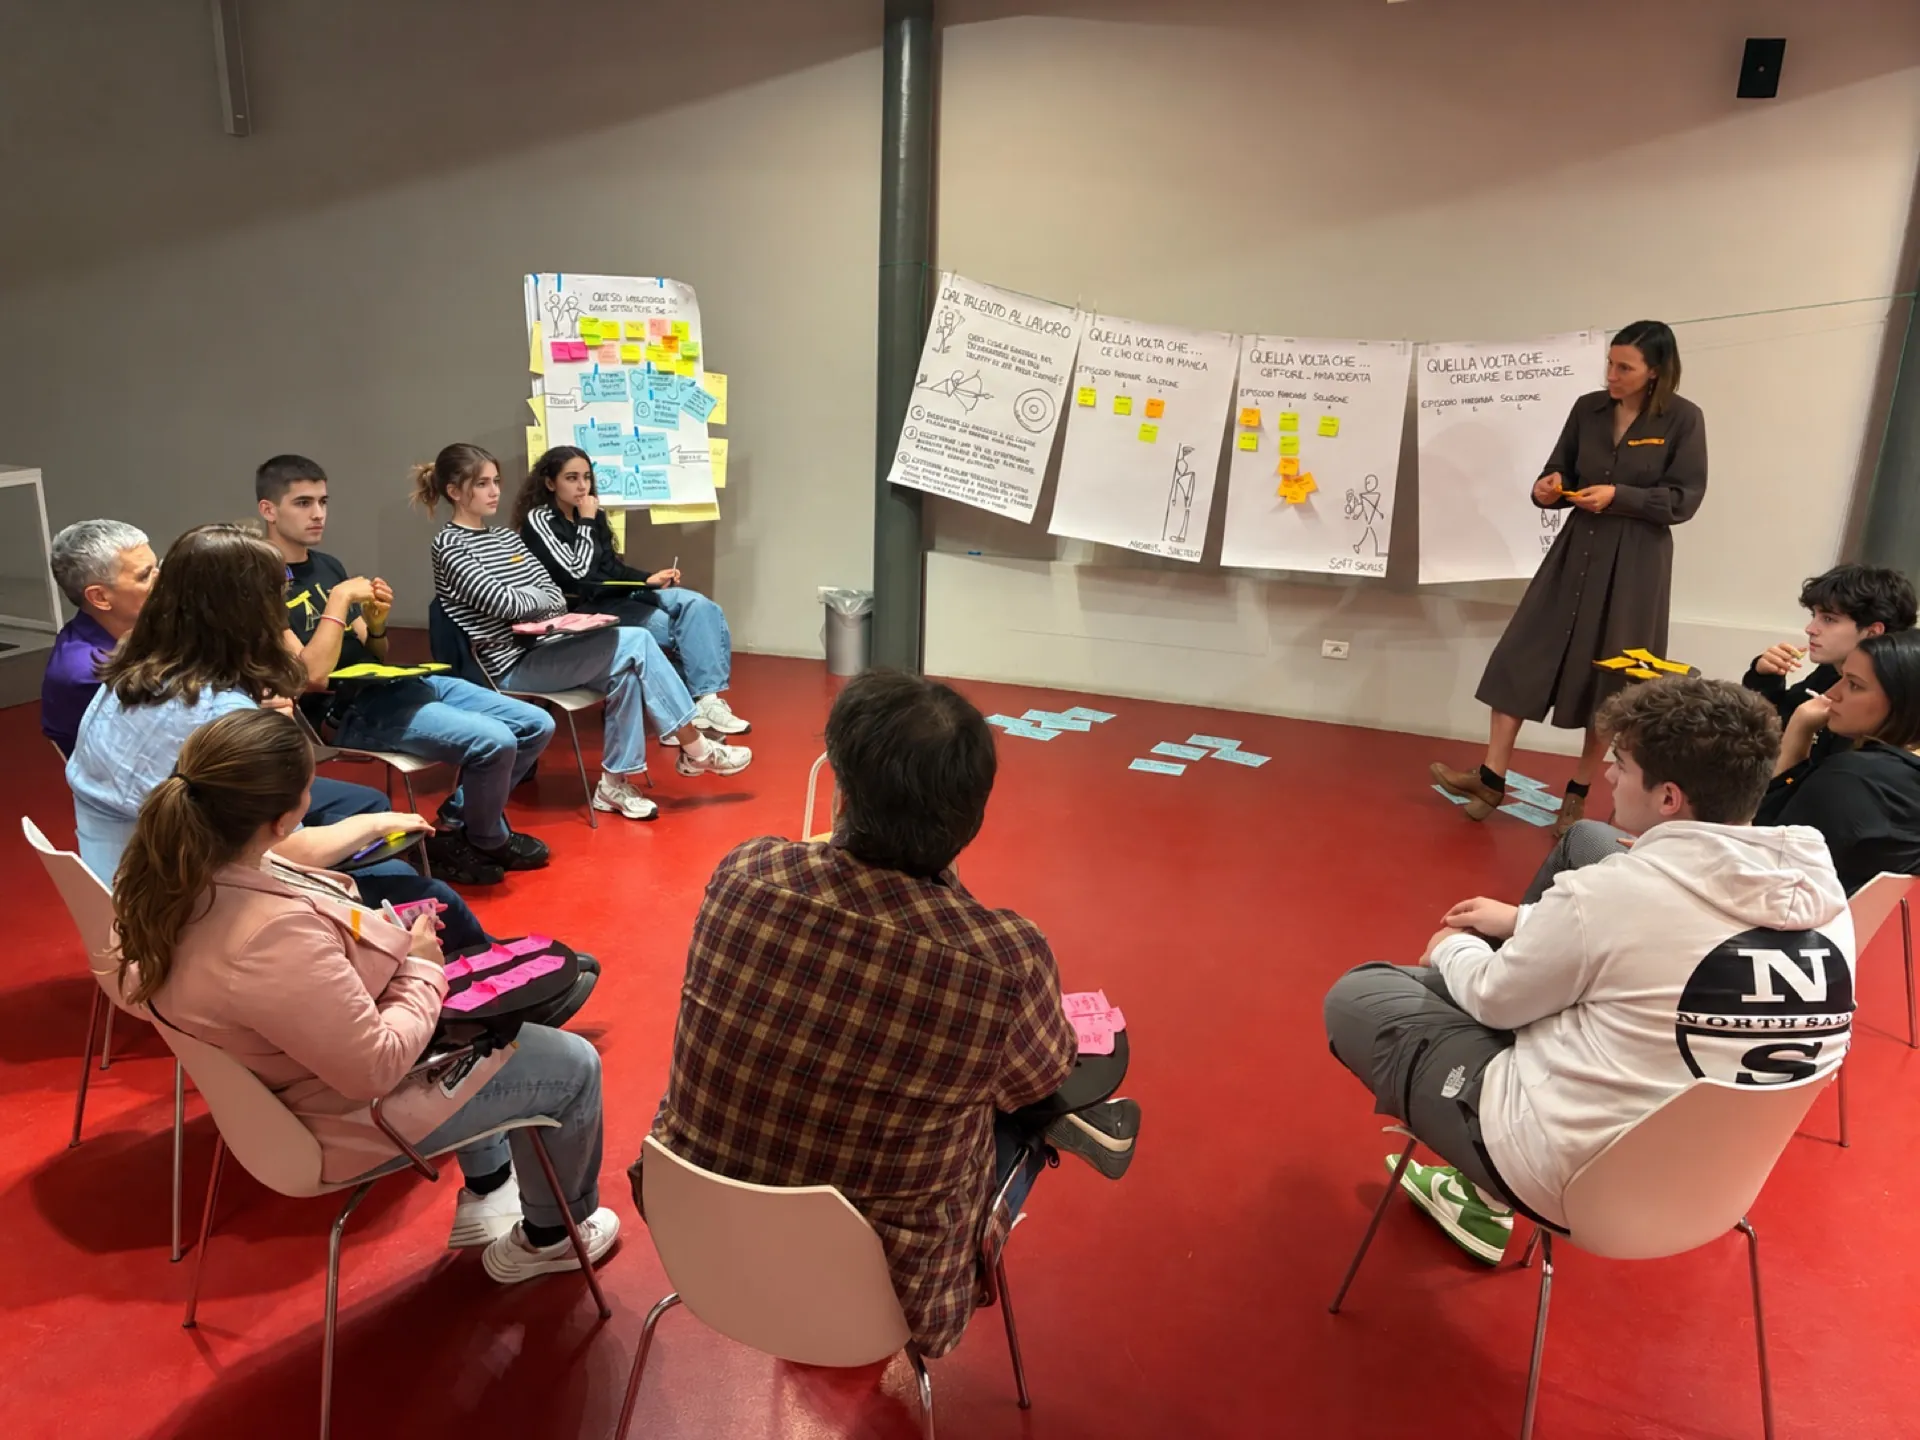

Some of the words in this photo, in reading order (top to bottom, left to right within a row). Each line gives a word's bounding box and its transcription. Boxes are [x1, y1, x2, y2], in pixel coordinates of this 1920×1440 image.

[942, 287, 960, 305] DAL
[963, 293, 1006, 318] TALENTO
[1008, 308, 1022, 325] AL
[1089, 327, 1131, 346] QUELLA
[1135, 336, 1164, 350] VOLTA
[1250, 349, 1294, 365] QUELLA
[1299, 354, 1330, 367] VOLTA
[1427, 356, 1477, 374] QUELLA
[1480, 353, 1517, 369] VOLTA
[1516, 365, 1575, 380] DISTANZE
[1738, 948, 1830, 1003] N
[1676, 1012, 1798, 1029] NORTH
